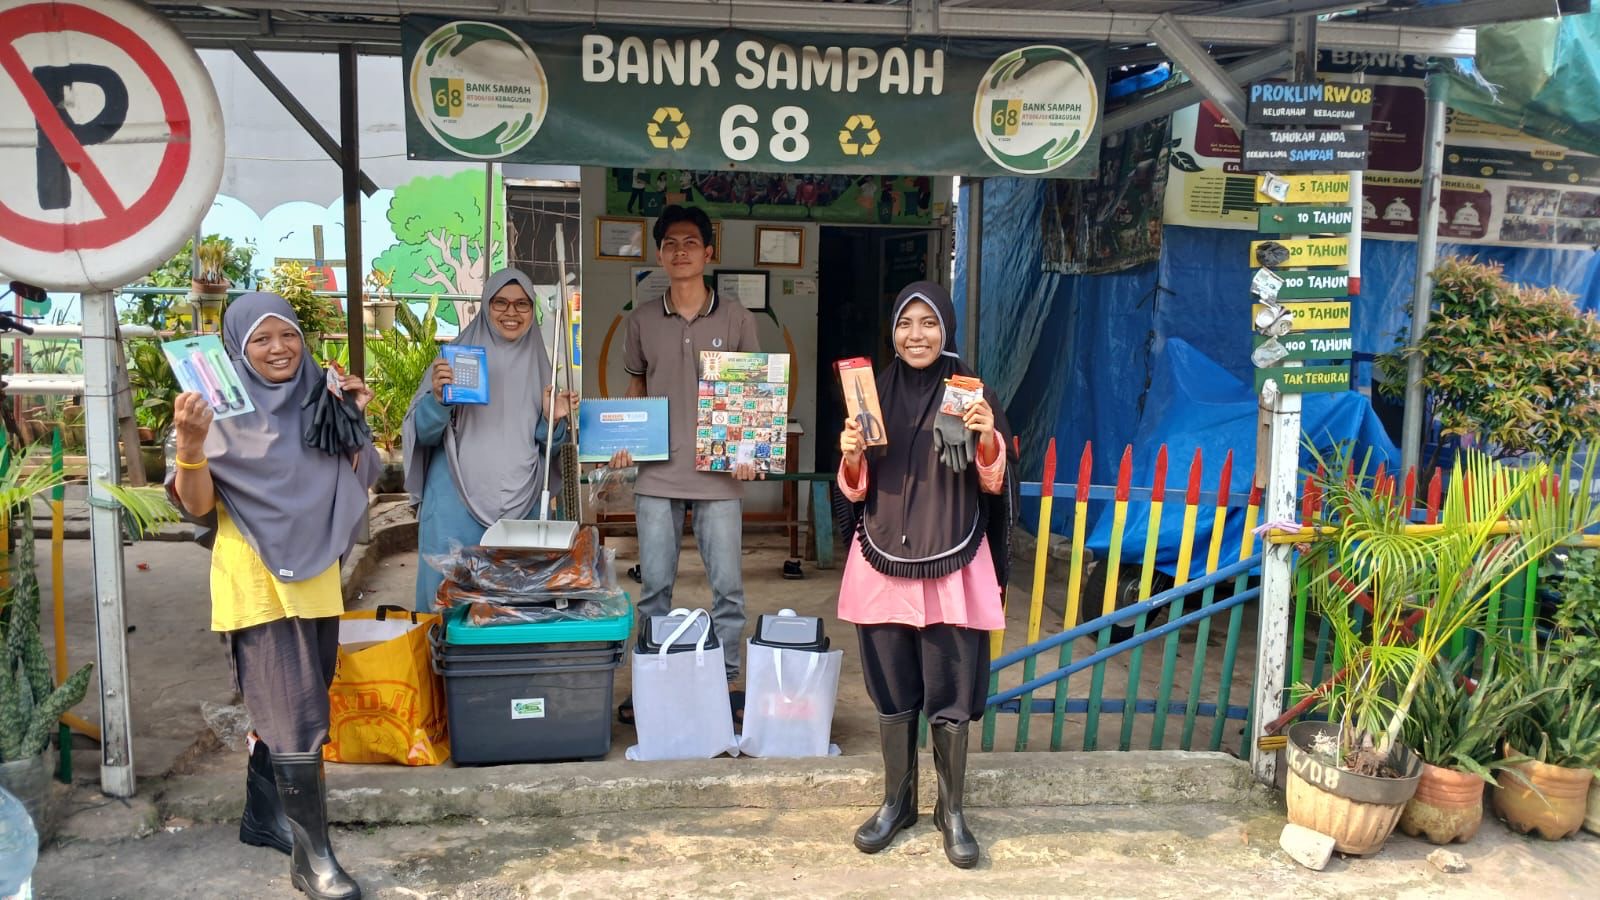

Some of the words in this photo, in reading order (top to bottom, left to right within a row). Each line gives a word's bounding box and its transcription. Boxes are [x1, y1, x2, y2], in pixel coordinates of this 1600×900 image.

[582, 34, 721, 87] BANK
[735, 40, 944, 95] SAMPAH
[466, 83, 491, 93] BANK
[493, 84, 531, 95] SAMPAH
[1251, 84, 1323, 103] PROKLIM
[435, 88, 463, 108] 68
[1022, 103, 1046, 112] BANK
[1047, 103, 1081, 112] SAMPAH
[1263, 107, 1306, 116] KELURAHAN
[1314, 109, 1355, 118] KEBAGUSAN
[993, 109, 1018, 127] 68
[32, 63, 129, 210] P
[719, 104, 810, 162] 68
[1270, 132, 1315, 143] TAHUKAH
[1319, 132, 1346, 143] ANDA
[1289, 149, 1333, 161] SAMPAH
[1299, 181, 1305, 191] 5
[1310, 181, 1349, 193] TAHUN
[1298, 213, 1308, 223] 10
[1313, 211, 1352, 225] TAHUN
[1290, 246, 1303, 255] 20
[1307, 244, 1347, 258] TAHUN
[1285, 278, 1304, 287] 100
[1307, 276, 1348, 290] TAHUN
[1308, 307, 1349, 320] TAHUN
[1285, 341, 1306, 350] 400
[1310, 338, 1352, 352] TAHUN
[1283, 374, 1303, 385] TAK
[1305, 372, 1348, 384] TERURAI
